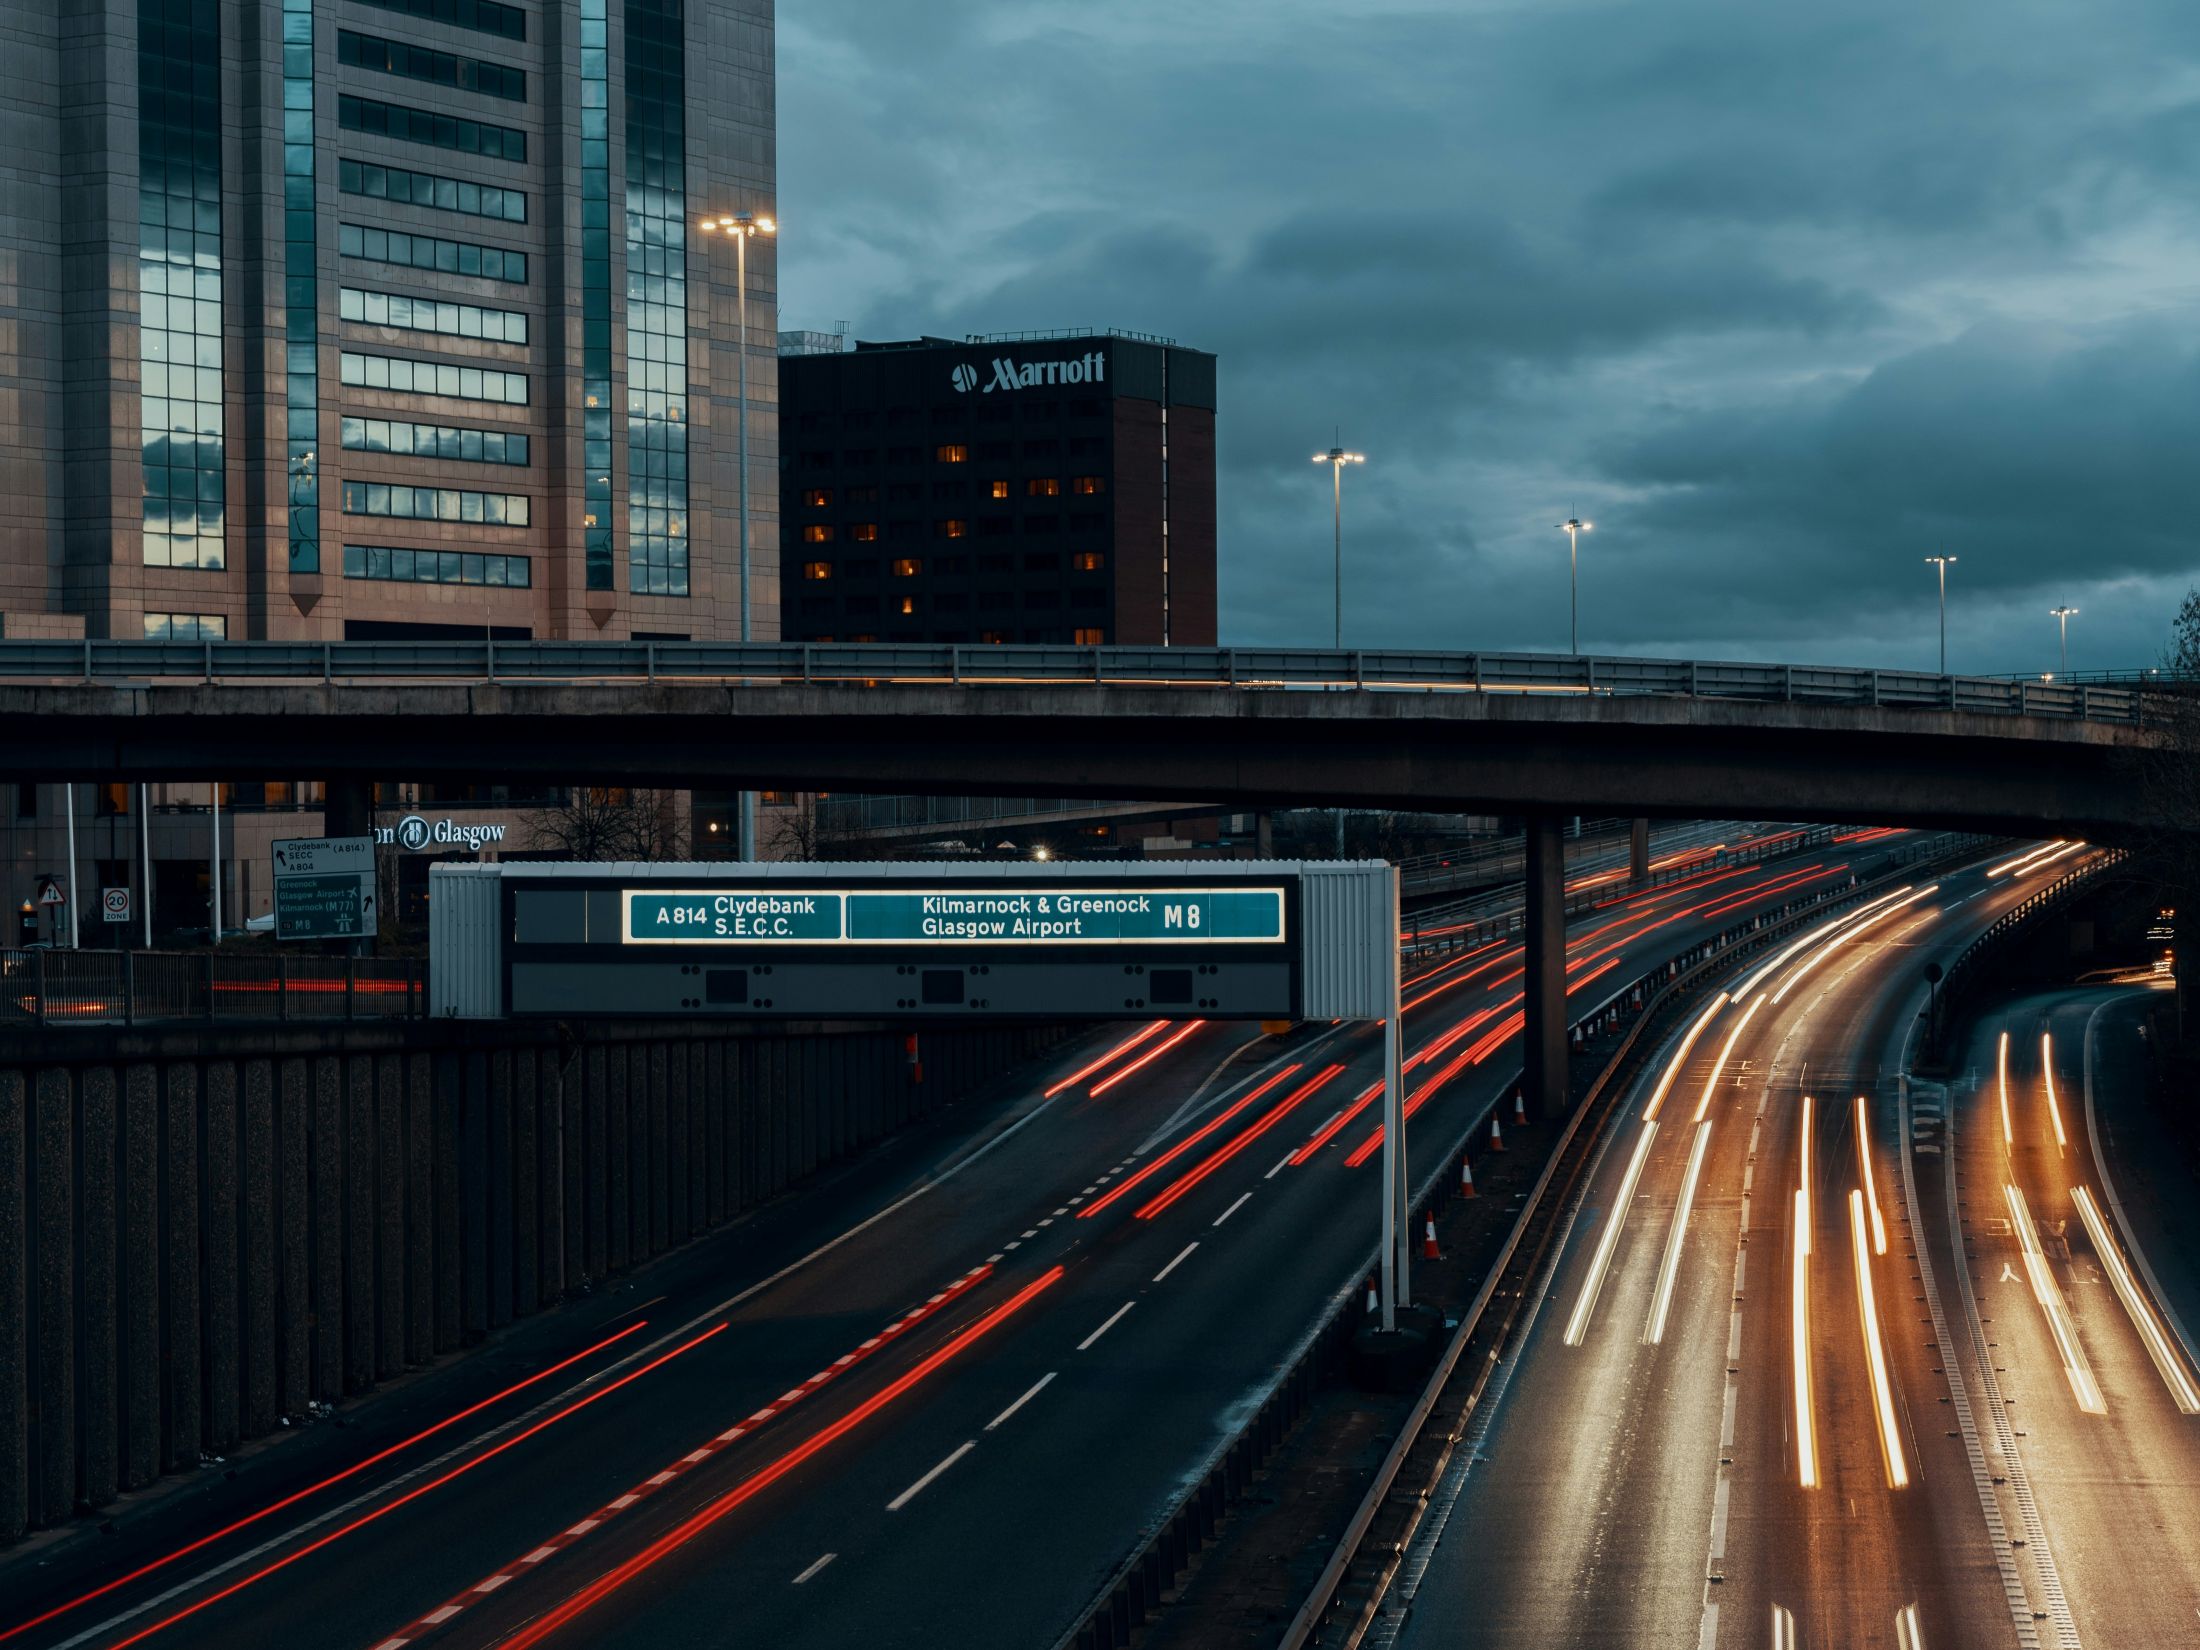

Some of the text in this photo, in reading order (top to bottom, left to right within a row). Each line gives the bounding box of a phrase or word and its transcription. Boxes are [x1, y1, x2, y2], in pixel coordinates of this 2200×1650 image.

[982, 351, 1105, 393] Marriott
[434, 819, 506, 851] Glasgow
[288, 842, 330, 852] Clydebank
[289, 851, 313, 859] SECC
[280, 881, 317, 889] Greenock
[109, 896, 124, 906] 20
[280, 890, 345, 901] Glasgow Airport
[280, 903, 323, 913] Kilmarnock
[714, 897, 815, 916] Clydebank
[922, 896, 1150, 914] Kilmarnock & Greenock
[714, 918, 793, 935] S.E.C.C.
[922, 917, 1082, 938] Glasgow Airport
